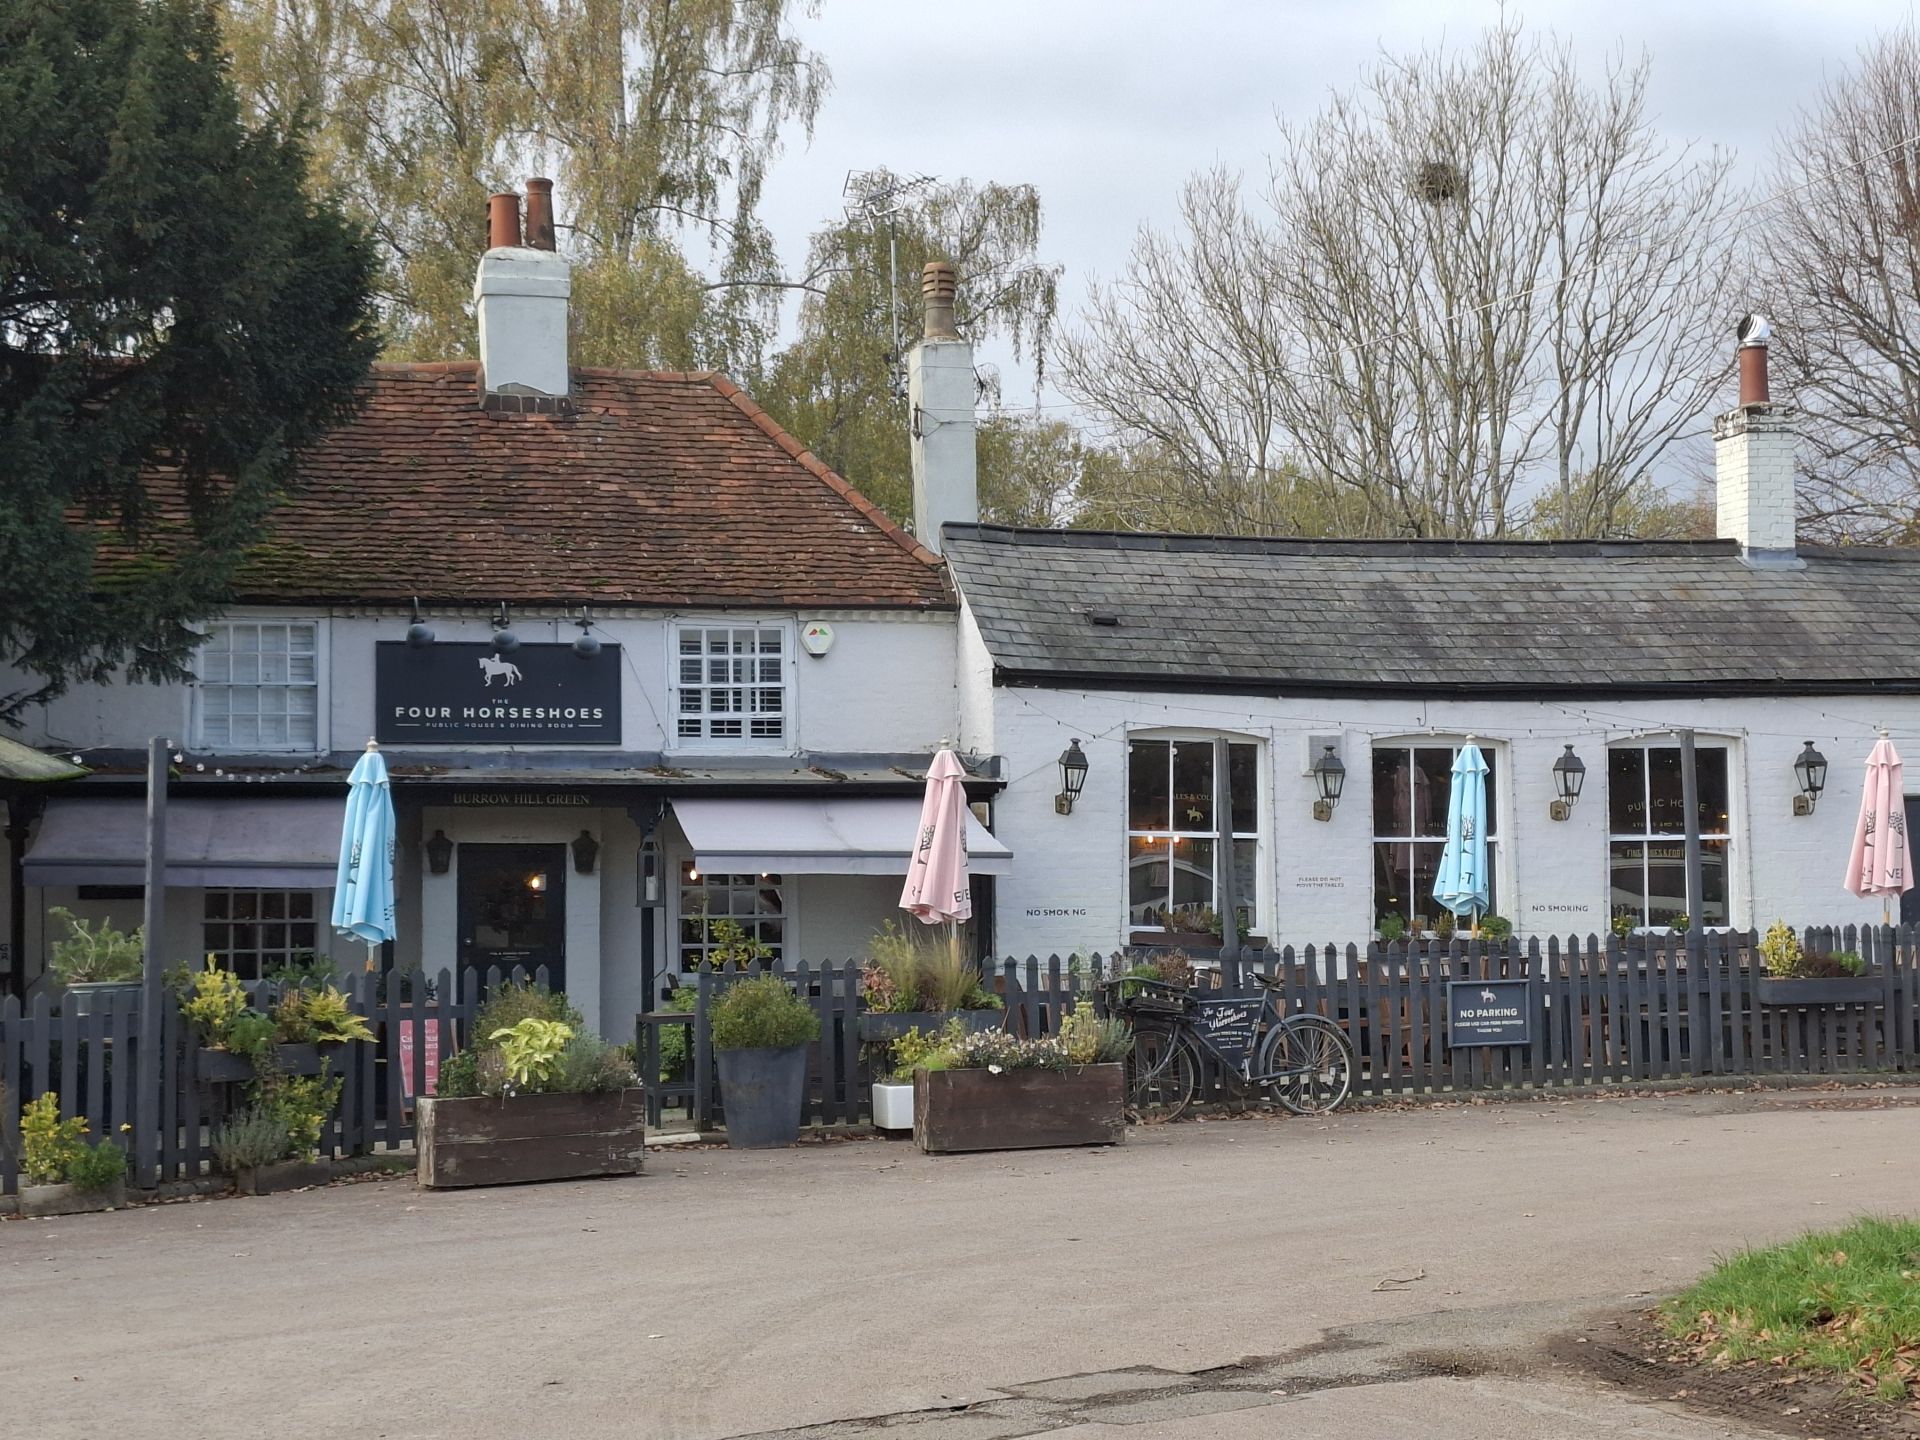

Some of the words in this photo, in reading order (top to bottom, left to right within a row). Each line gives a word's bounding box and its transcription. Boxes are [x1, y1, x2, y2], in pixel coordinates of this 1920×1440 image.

[395, 707, 451, 718] FOUR
[463, 707, 603, 719] HORSESHOES
[454, 793, 510, 804] BURROW
[514, 794, 544, 804] HILL
[546, 794, 590, 805] GREEN
[1548, 904, 1589, 912] SMOKING
[1460, 1009, 1474, 1018] NO
[1476, 1007, 1518, 1018] PARKING
